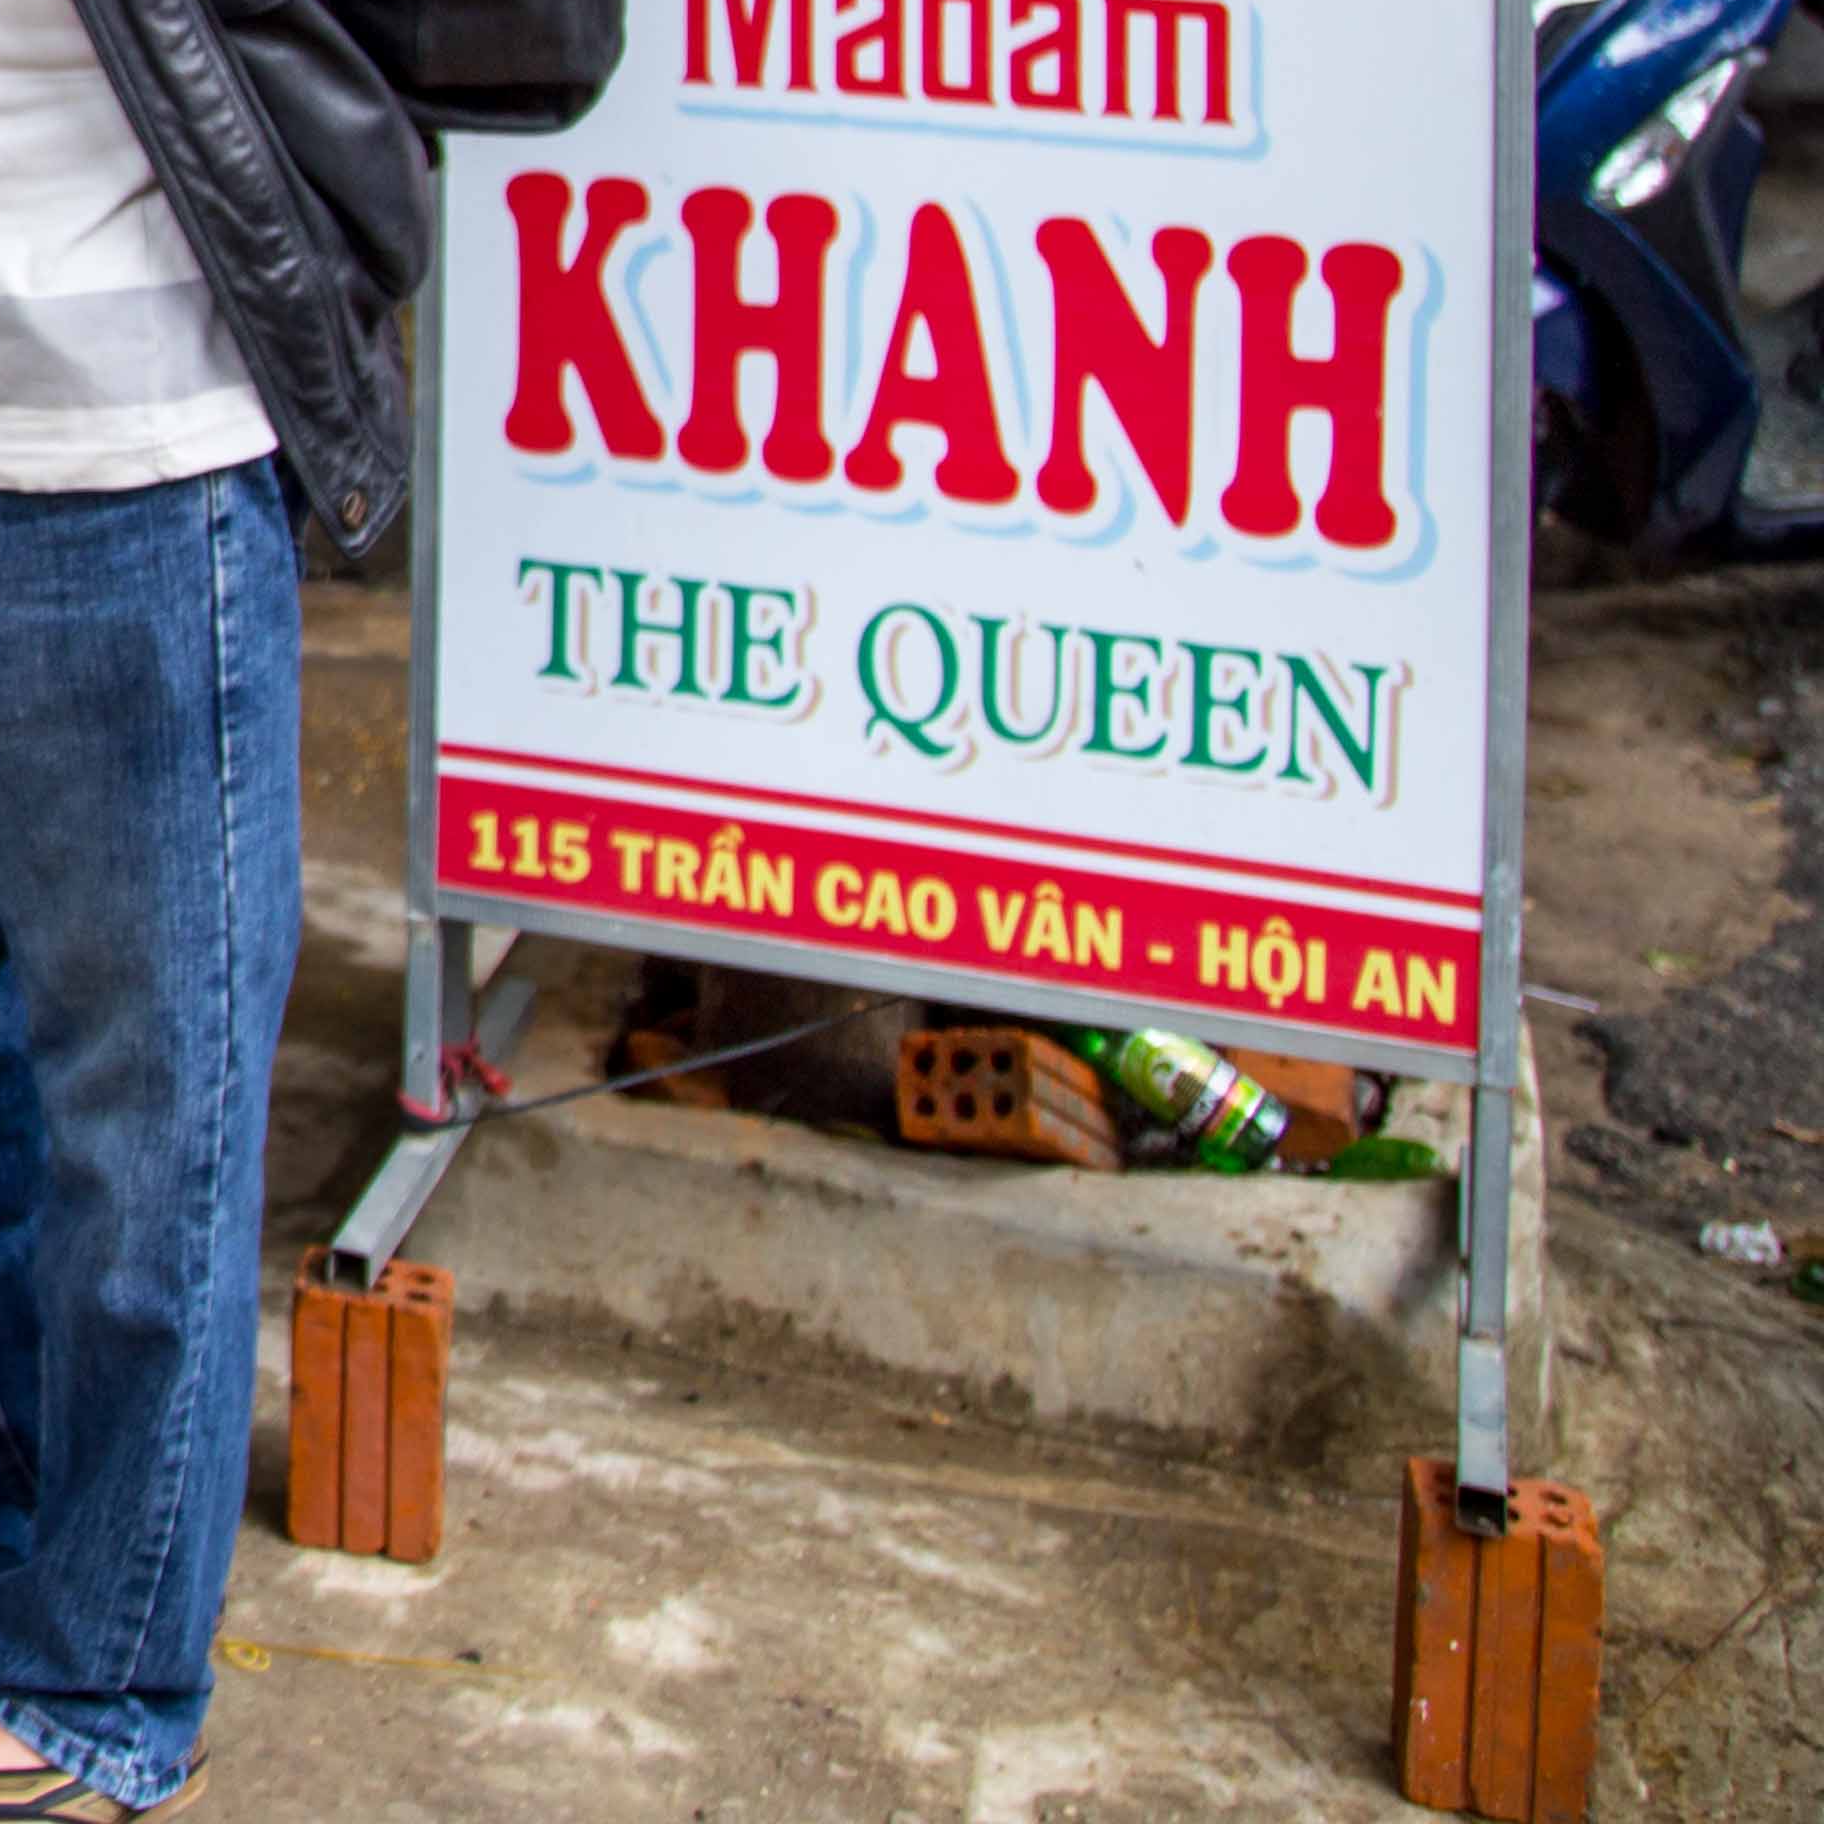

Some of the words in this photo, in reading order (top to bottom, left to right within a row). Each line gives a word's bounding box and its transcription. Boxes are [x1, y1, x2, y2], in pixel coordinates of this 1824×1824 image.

[505, 170, 1405, 550] KHANH
[517, 556, 804, 711] THE
[856, 601, 1389, 794] QUEEN
[471, 813, 590, 883] 115
[611, 825, 794, 915] TRẦN
[815, 864, 957, 940] CAO
[978, 882, 1123, 969] VÂN
[1198, 916, 1327, 1007] HỘI
[1352, 948, 1456, 1024] AN
